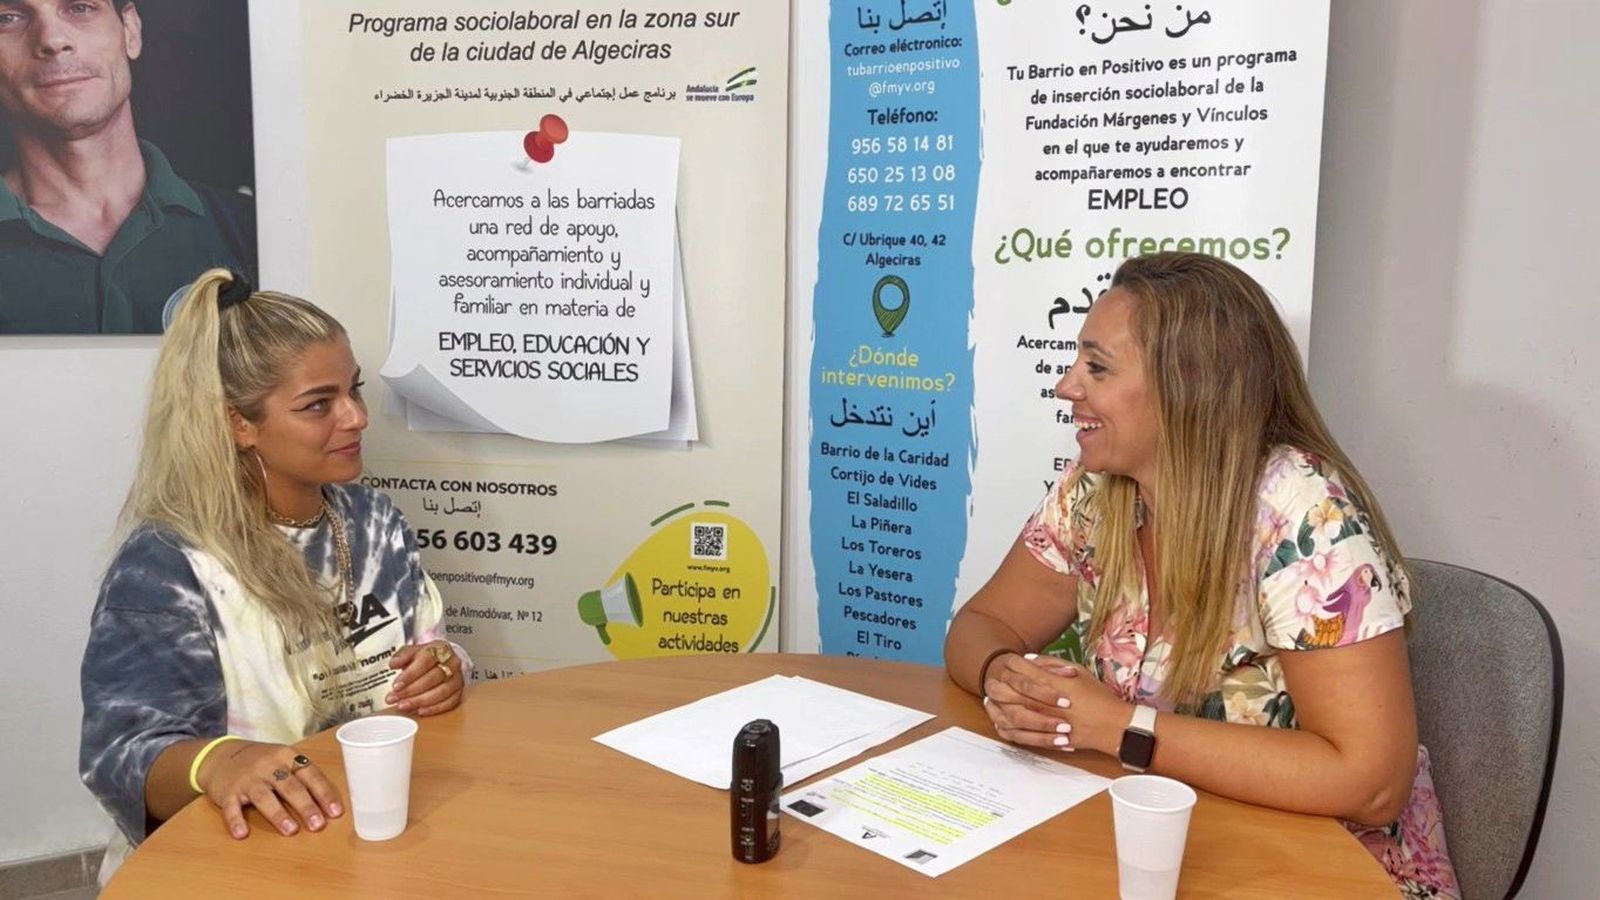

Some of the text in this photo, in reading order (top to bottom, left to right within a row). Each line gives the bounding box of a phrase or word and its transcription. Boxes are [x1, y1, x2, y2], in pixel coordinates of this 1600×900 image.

[349, 9, 740, 37] Programa sociolaboral en la zona sur
[857, 6, 881, 34] بنا
[1076, 4, 1211, 44] من نحن؟
[410, 39, 672, 65] de la ciudad de Algeciras
[844, 36, 963, 57] Correo eléctronico:
[847, 57, 961, 76] tubarrioenpositivo
[1007, 50, 1297, 81] Tu Barrio en Positivo es un programa
[869, 80, 935, 98] @fmyv.org
[1031, 76, 1264, 105] de inserción sociolaboral de la
[867, 107, 939, 125] Teléfono:
[1026, 105, 1268, 132] Fundación Márgenes y Vínculos
[852, 135, 953, 155] 956 58 14 81
[1043, 135, 1244, 158] en el que te ayudaremos y
[848, 165, 956, 184] 650 25 13 08
[1035, 164, 1251, 184] acompañaremos a encontrar
[433, 188, 655, 210] Acercamos a las barriadas
[848, 195, 955, 212] 689 72 65 51
[1087, 187, 1188, 210] EMPLEO
[469, 215, 618, 243] una red de apoyo,
[843, 233, 946, 249] C/ Ubrique 40, 42
[994, 227, 1290, 264] ¿Qué ofrecemos?
[466, 245, 621, 270] acompañamiento y
[866, 253, 921, 268] Algeciras
[439, 269, 650, 298] asesoramiento individual y
[454, 292, 636, 317] familiar en materia de
[439, 332, 650, 355] EMPLEO, EDUCACIÓN Y
[1017, 335, 1076, 350] Acercam
[849, 345, 919, 368] ¿Dónde
[1035, 360, 1051, 374] de
[450, 359, 639, 382] SERVICIOS SOCIALES
[822, 367, 956, 392] intervenimos?
[830, 397, 936, 437] أين نتدخل
[820, 442, 949, 467] Barrio de la Caridad
[361, 477, 557, 496] CONTACTA CON NOSOTROS
[830, 466, 937, 490] Cortijo de Vides
[423, 497, 438, 515] بنا
[847, 491, 918, 512] El Saladillo
[852, 515, 912, 535] La Piñera
[417, 529, 557, 555] 56 603 439
[842, 537, 922, 560] Los Toreros
[428, 570, 535, 589] oenpositivo@fmyv.org
[849, 561, 913, 582] La Yesera
[652, 577, 740, 603] Participa en
[839, 582, 923, 608] Los Pastores
[445, 606, 458, 617] de
[460, 606, 513, 621] Almodóvar,
[532, 611, 543, 622] 12
[663, 608, 728, 626] nuestras
[844, 605, 917, 630] Pescadores
[446, 623, 473, 634] eciras
[658, 633, 739, 653] actividades
[857, 631, 902, 650] El Tiro
